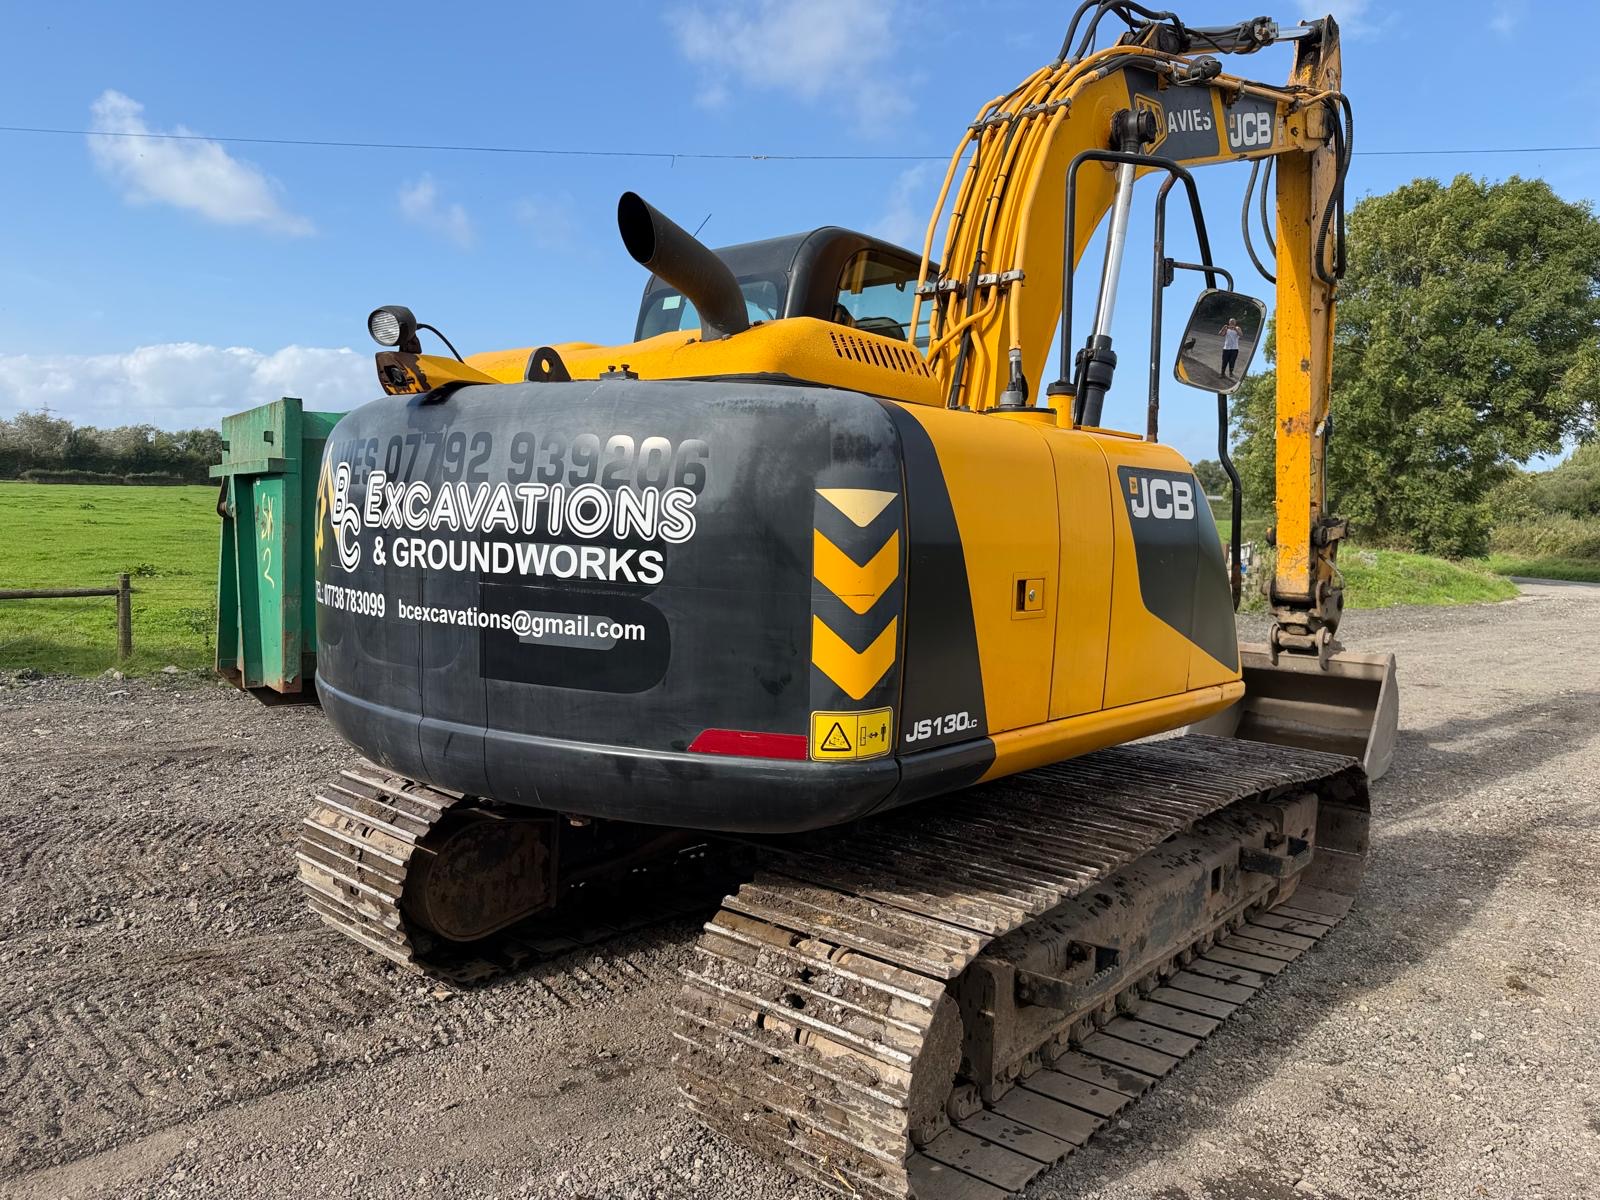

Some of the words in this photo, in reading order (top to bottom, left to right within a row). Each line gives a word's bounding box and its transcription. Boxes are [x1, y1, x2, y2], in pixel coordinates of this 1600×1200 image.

[1230, 112, 1271, 147] JCB
[507, 431, 709, 497] 939206
[364, 470, 697, 543] EXCAVATIONS
[1131, 477, 1195, 520] JCB
[373, 536, 387, 566] &
[392, 537, 664, 584] GROUNDWORKS
[345, 588, 385, 618] 783099
[398, 598, 646, 641] bcexcavations@gmail.com
